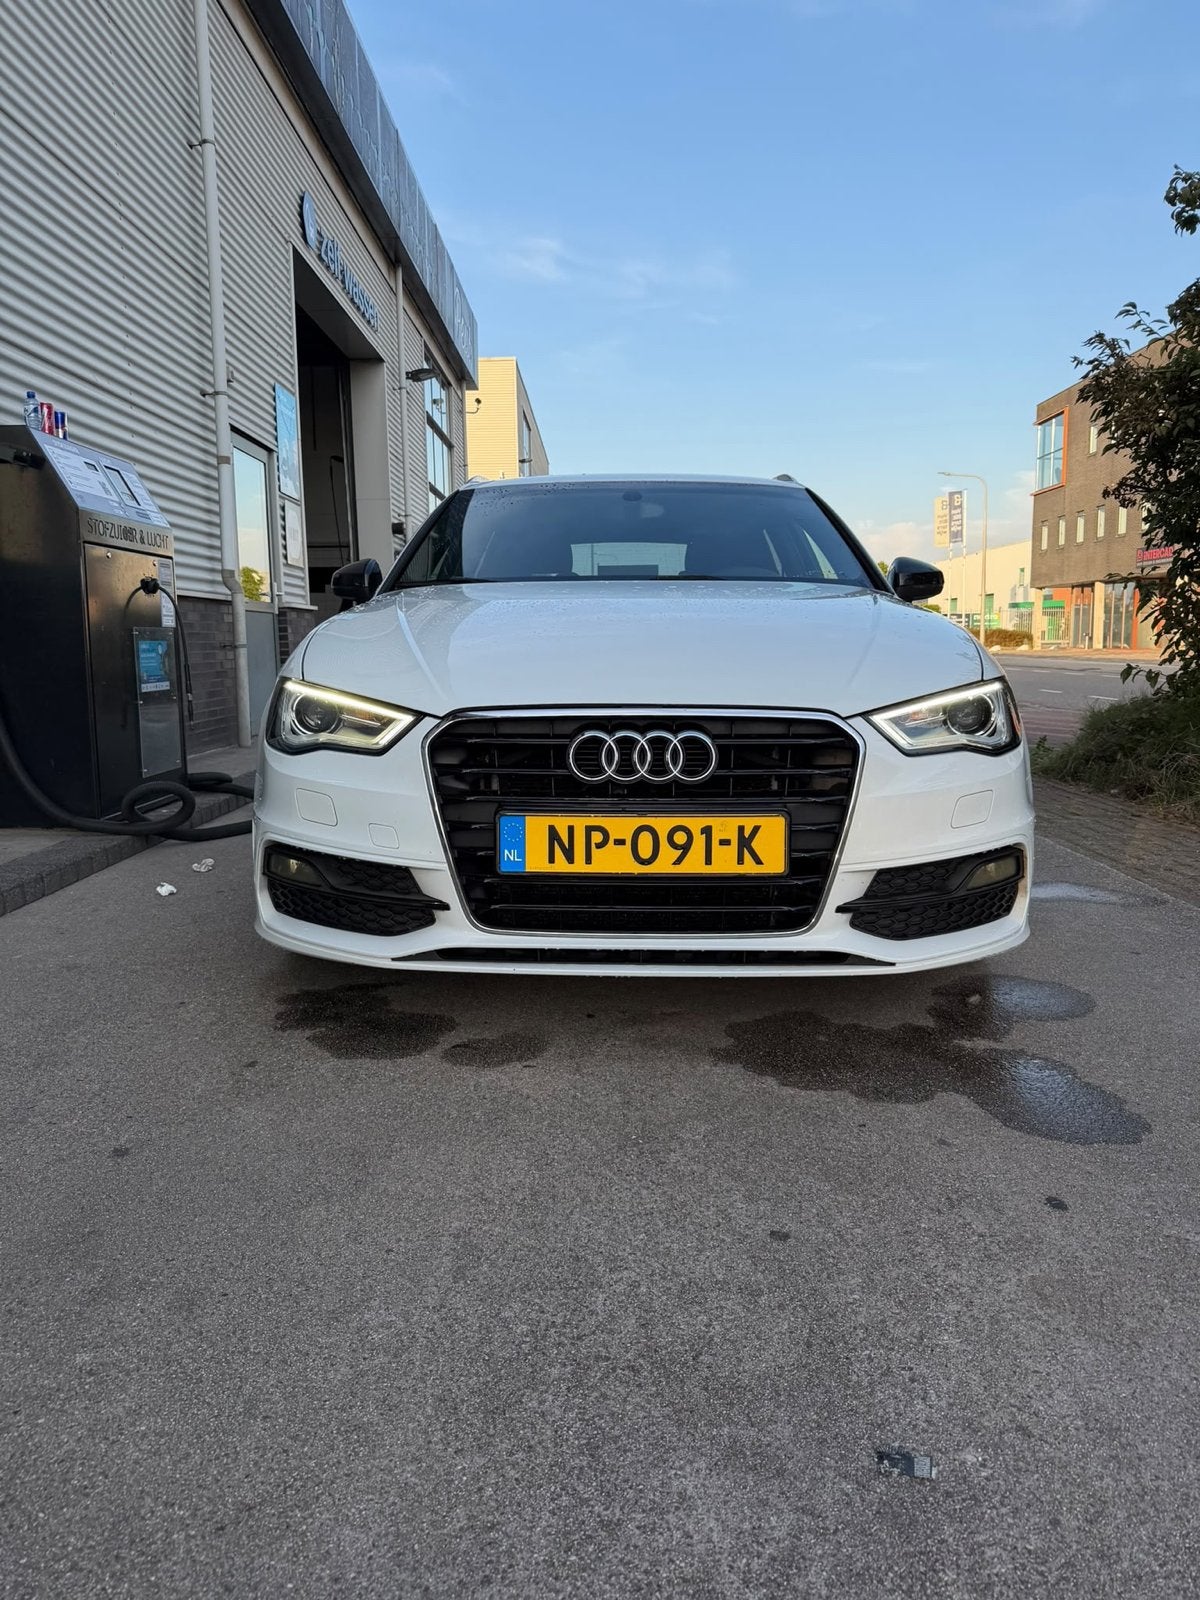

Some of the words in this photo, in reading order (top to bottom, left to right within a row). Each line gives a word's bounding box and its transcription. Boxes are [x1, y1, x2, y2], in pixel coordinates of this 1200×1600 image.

[343, 258, 379, 332] wassen
[87, 517, 138, 544] STOFZUIGER
[139, 530, 146, 546] &
[146, 532, 169, 550] LUCHT
[504, 849, 522, 862] NL
[547, 824, 765, 866] NP-091-K
